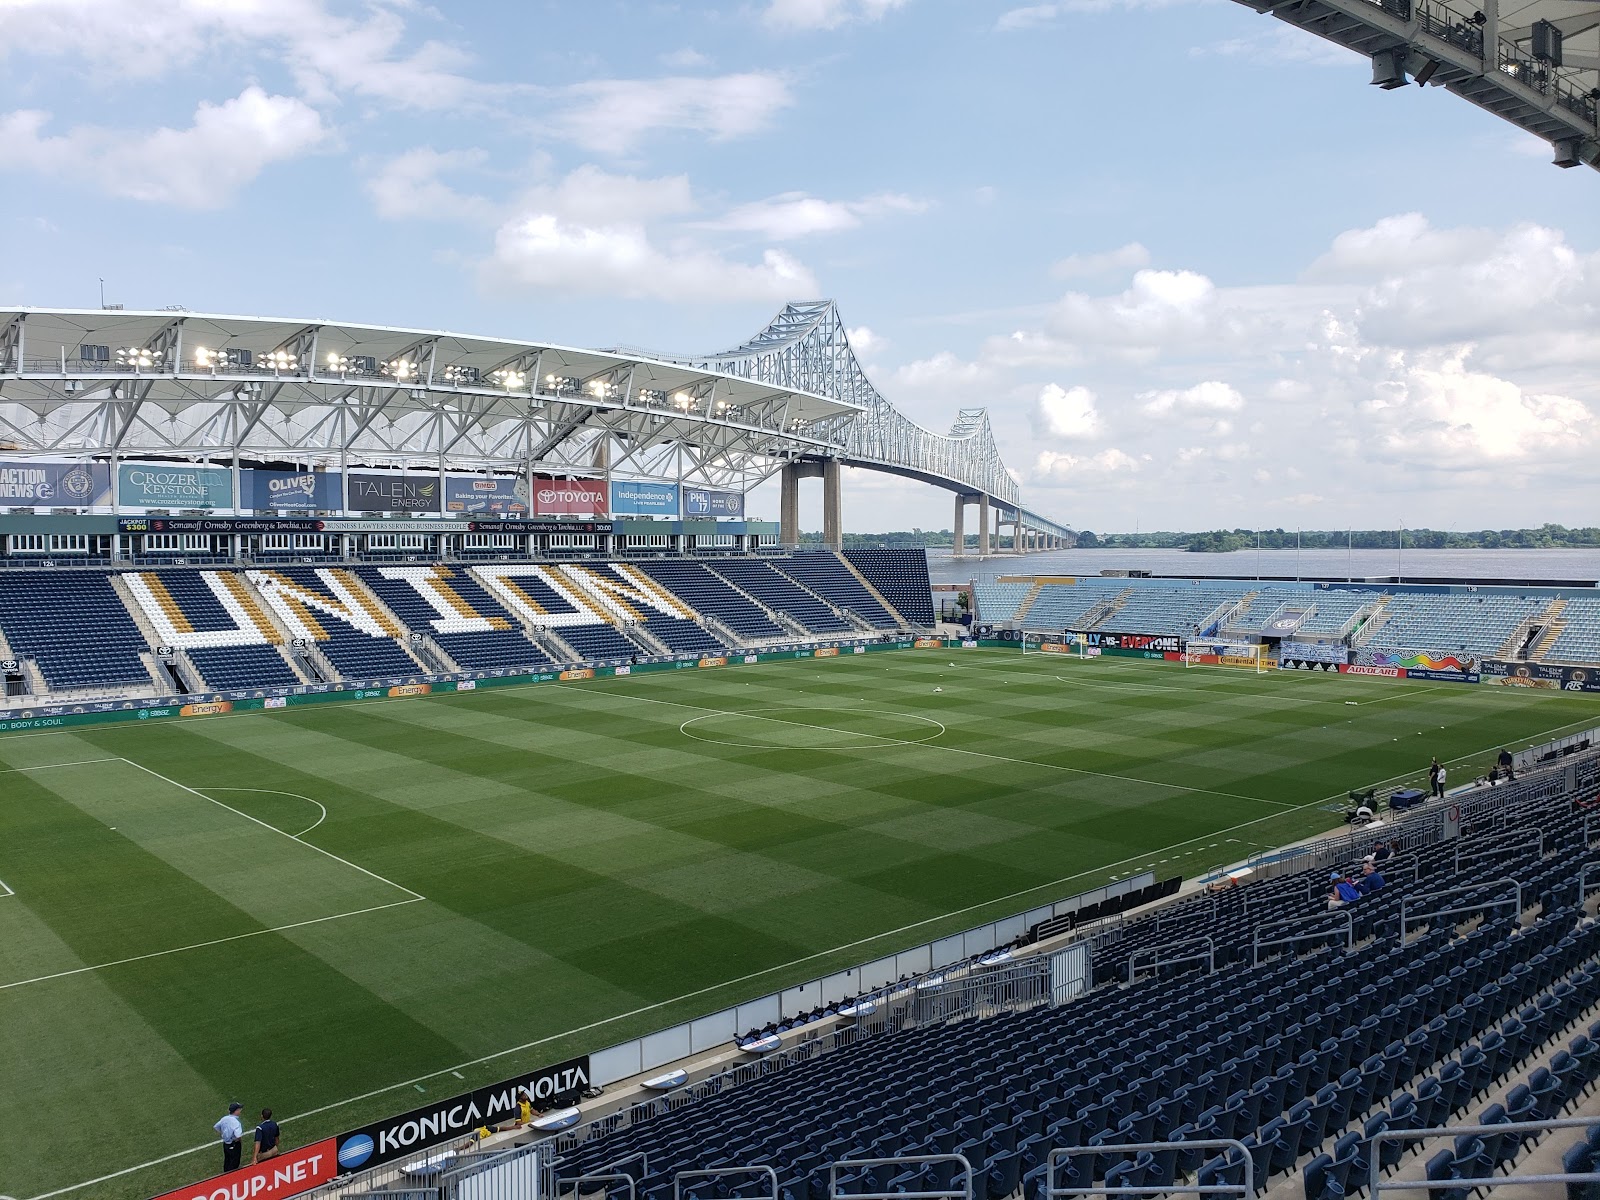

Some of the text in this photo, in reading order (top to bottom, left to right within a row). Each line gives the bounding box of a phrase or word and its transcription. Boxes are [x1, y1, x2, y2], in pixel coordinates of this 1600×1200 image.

[0, 468, 46, 484] ACTION
[268, 474, 316, 492] OLIVER
[0, 484, 34, 498] NEWS
[142, 484, 208, 496] KEYSTONE
[354, 481, 416, 498] TALEN
[557, 492, 604, 502] TOYOTA
[618, 491, 665, 500] Independence
[690, 493, 707, 502] PHL
[392, 498, 432, 508] ENERGY
[699, 502, 708, 511] 17
[169, 520, 201, 531] Semanoff
[204, 522, 232, 530] Ormsby
[235, 522, 269, 531] Greenberg
[480, 523, 503, 531] Semanoff
[506, 523, 526, 531] Ormsby
[121, 565, 703, 650] UNION
[1121, 636, 1178, 651] EVERYONE
[1220, 656, 1254, 664] Continental
[1348, 666, 1398, 676] ADVOCARE
[398, 686, 424, 695] Energy
[1565, 681, 1584, 690] RTS
[192, 705, 222, 713] Energy
[380, 1066, 588, 1154] KONICA MINOLTA
